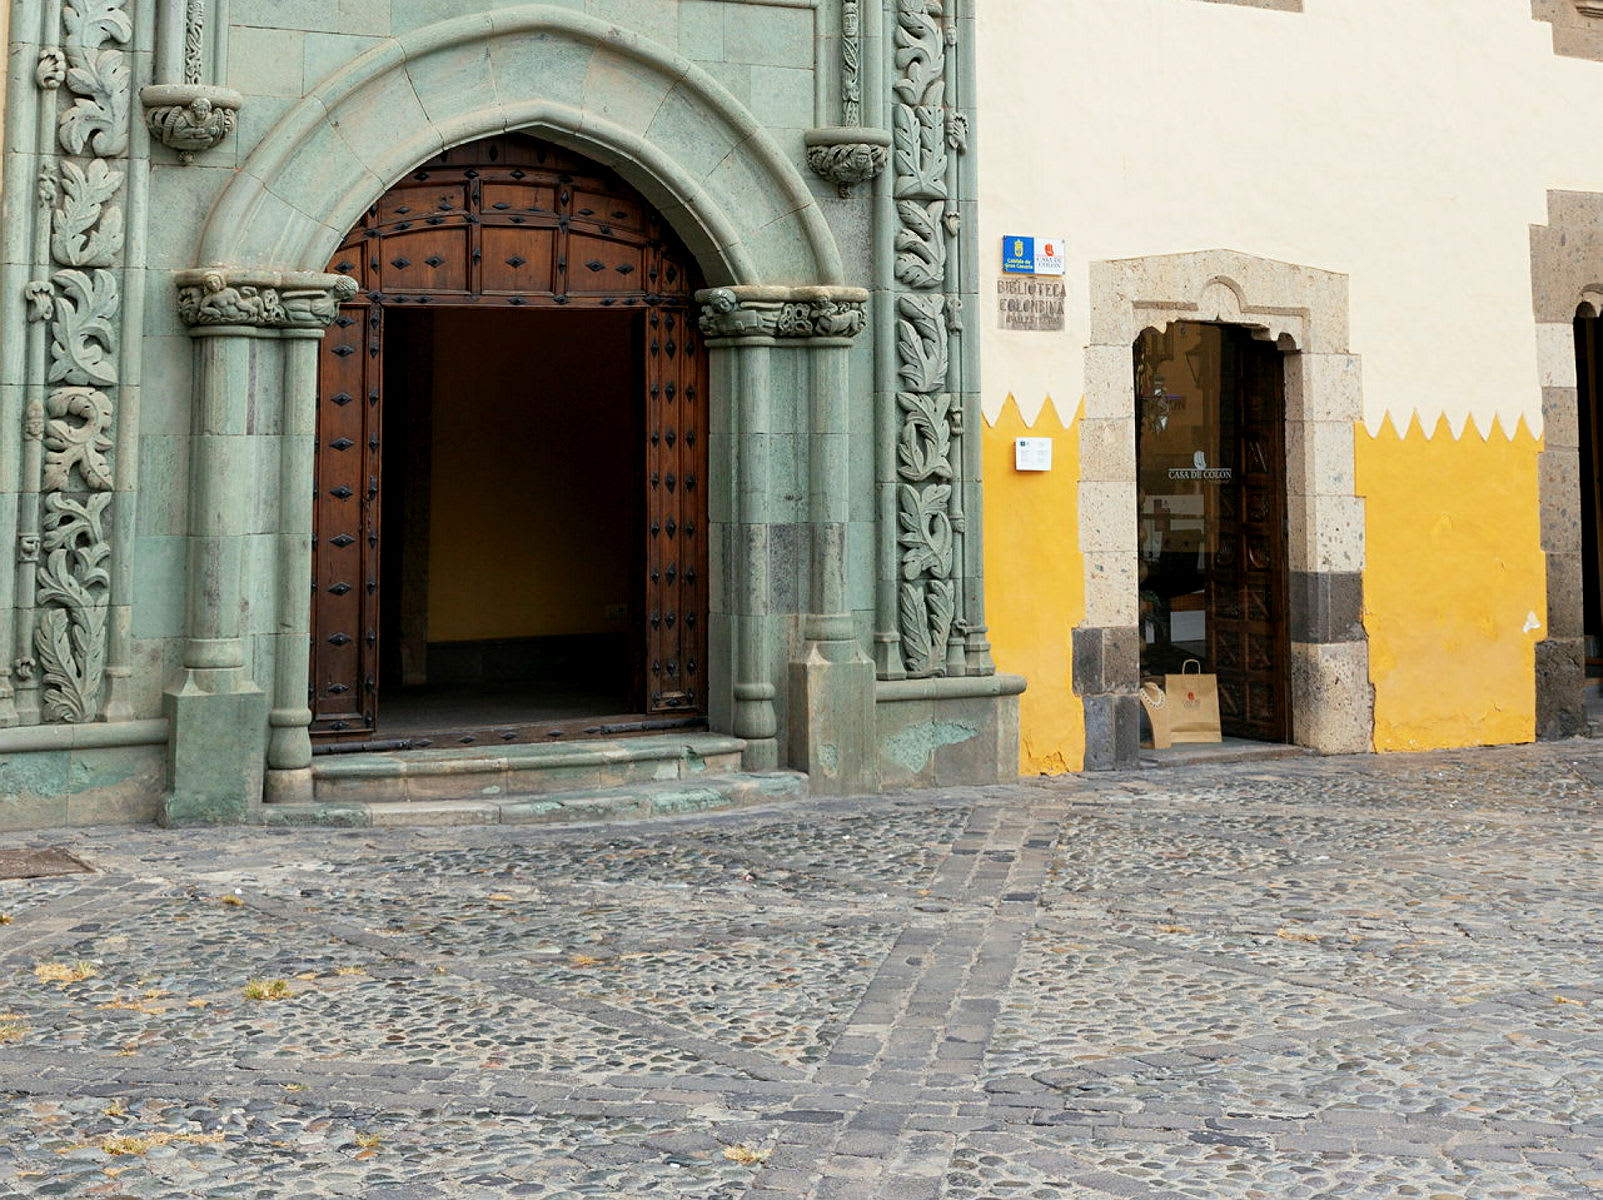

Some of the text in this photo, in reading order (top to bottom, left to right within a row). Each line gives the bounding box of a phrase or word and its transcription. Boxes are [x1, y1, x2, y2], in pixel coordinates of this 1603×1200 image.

[997, 280, 1066, 297] BIBLIOTECA
[1168, 471, 1189, 479] CASA
[1191, 471, 1202, 479] DE
